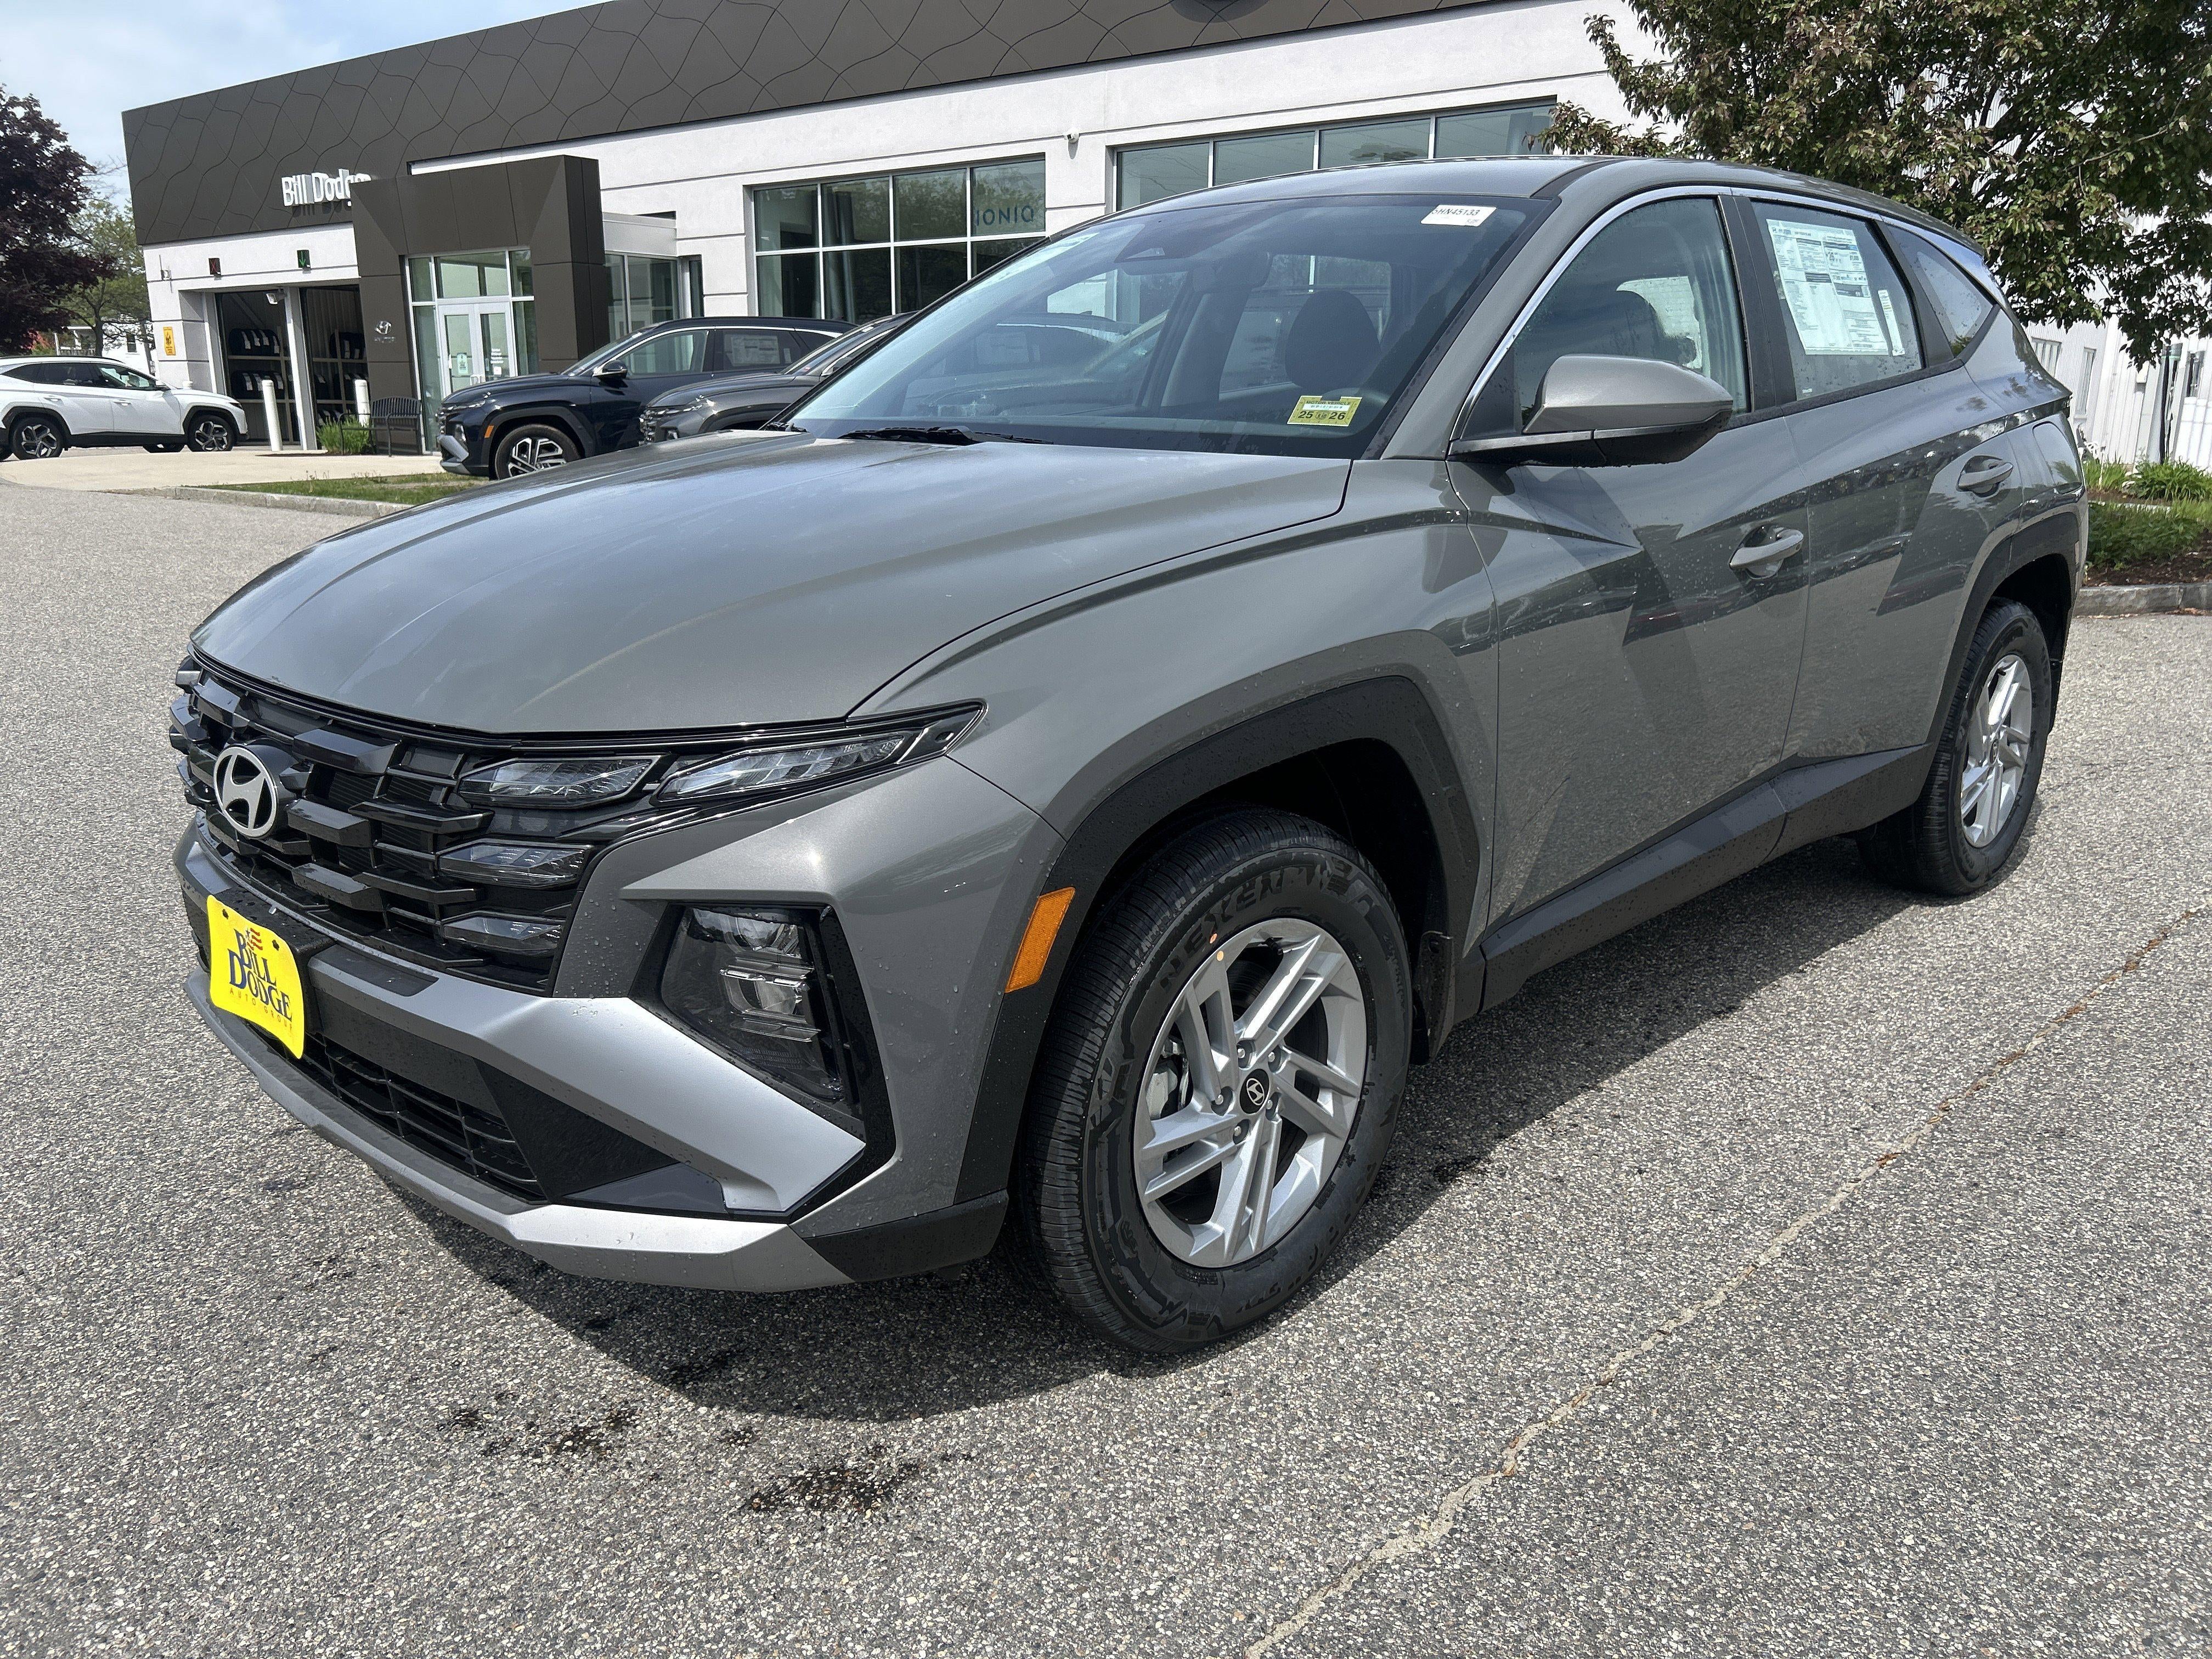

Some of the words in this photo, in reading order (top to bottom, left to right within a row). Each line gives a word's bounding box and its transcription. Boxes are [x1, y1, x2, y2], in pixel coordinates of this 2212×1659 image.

[281, 174, 313, 206] Bill
[976, 205, 1034, 226] IONIQ
[1297, 410, 1314, 419] 25
[1328, 411, 1346, 420] 26
[234, 928, 276, 986] BILL
[227, 948, 292, 1023] DODGE
[229, 987, 256, 1006] AUTO
[263, 1006, 293, 1033] GROUP
